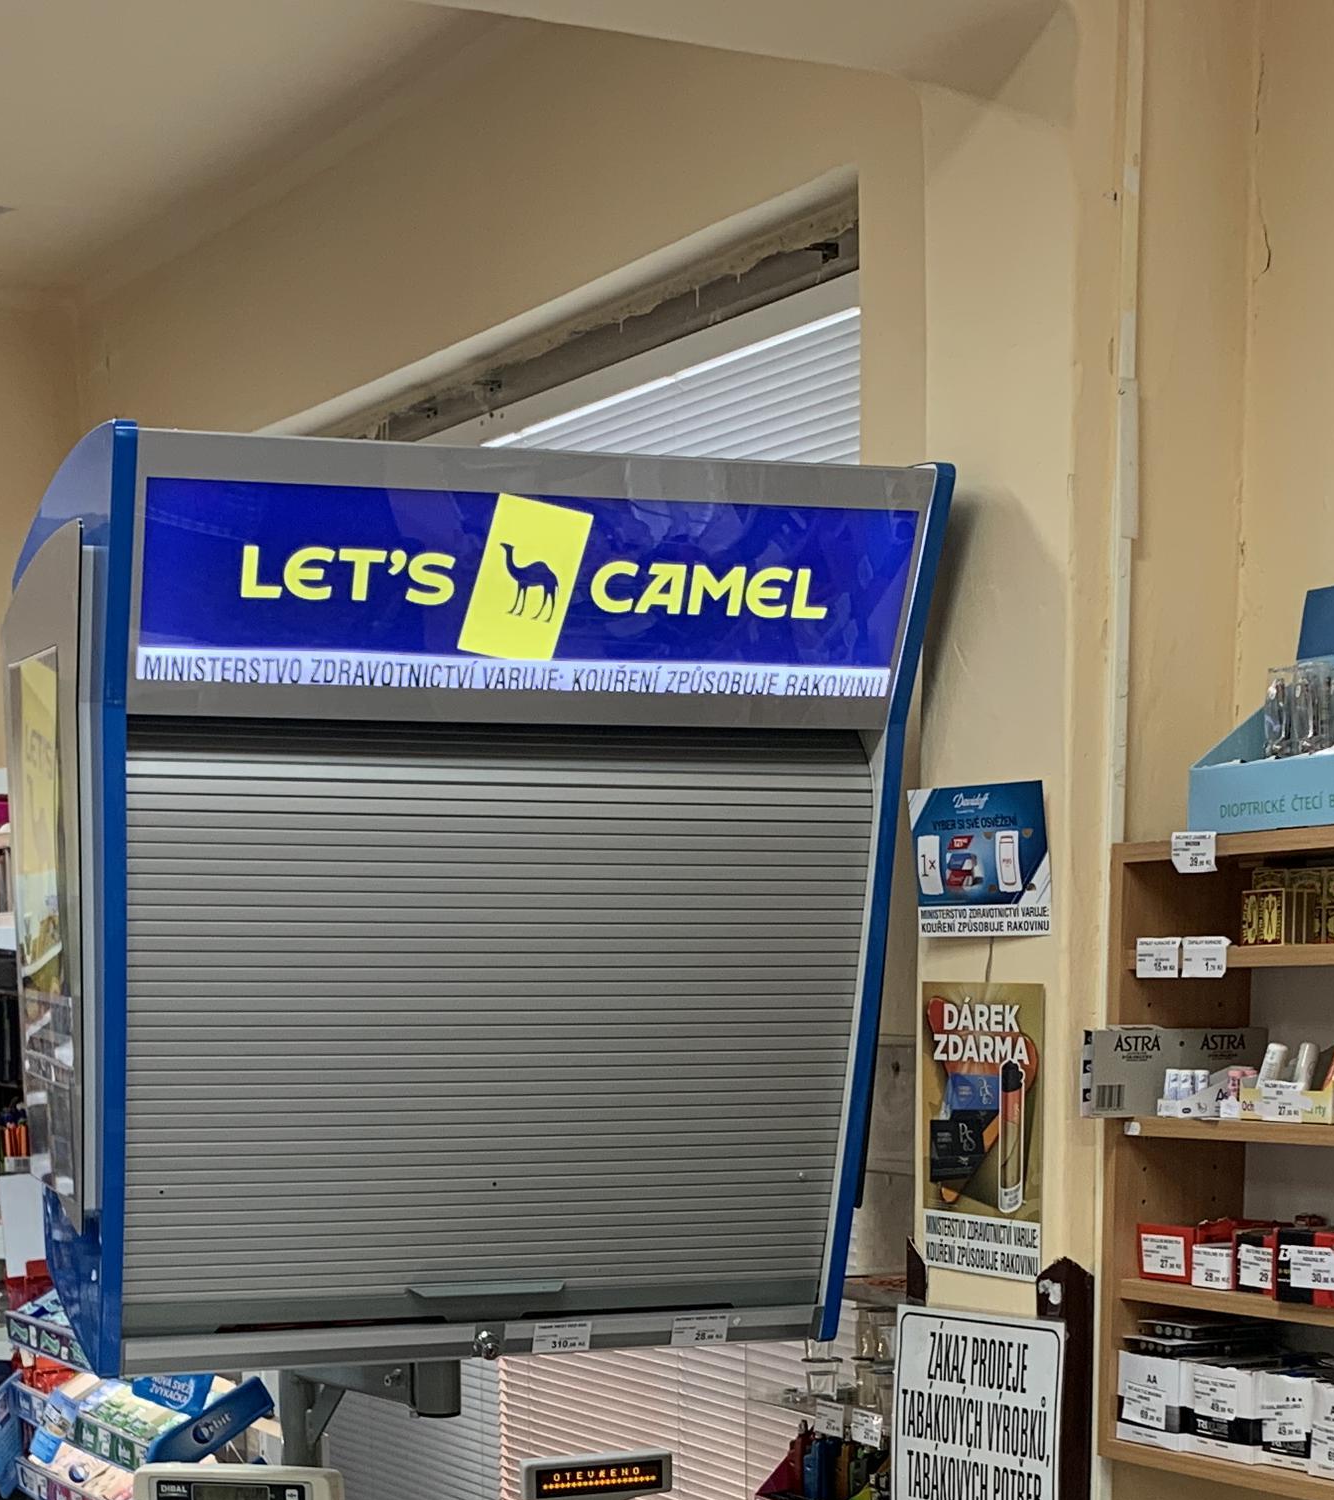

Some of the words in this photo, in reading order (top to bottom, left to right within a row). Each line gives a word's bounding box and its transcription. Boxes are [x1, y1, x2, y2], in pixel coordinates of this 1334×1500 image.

[239, 543, 456, 606] LET'S
[589, 561, 829, 620] CAMEL
[142, 655, 303, 684] MINISTERSTVO
[309, 658, 478, 689] ZDRAVOTNICTVÍ
[571, 664, 663, 693] KOUŘENÍ
[666, 664, 778, 696] ZPŮSOBUJE
[1219, 790, 1286, 819] DIOPTRICKÉ
[1290, 790, 1324, 812] ČTECÍ
[920, 920, 957, 934] KOUŘENÍ
[957, 918, 1005, 933] ZPŮSOBUJE
[1006, 919, 1050, 932] RAKOVINU
[942, 996, 1022, 1033] DÁREK
[932, 1033, 1031, 1066] ZDARMA
[1114, 1033, 1161, 1053] ASTRA
[1200, 1033, 1246, 1051] ASTRA
[925, 1238, 956, 1266] KOUŘENÍ
[956, 1243, 999, 1272] ZPŮSOBUJE
[999, 1250, 1039, 1278] RAKOVINU
[927, 1320, 968, 1386] ZÁKAZ
[970, 1336, 1029, 1395] PRODEJE
[1146, 1374, 1158, 1385] AA
[901, 1380, 983, 1450] TABÁKOVÝCH
[986, 1392, 1051, 1468] VÝROBKŮ,
[160, 1484, 188, 1494] DIBAL
